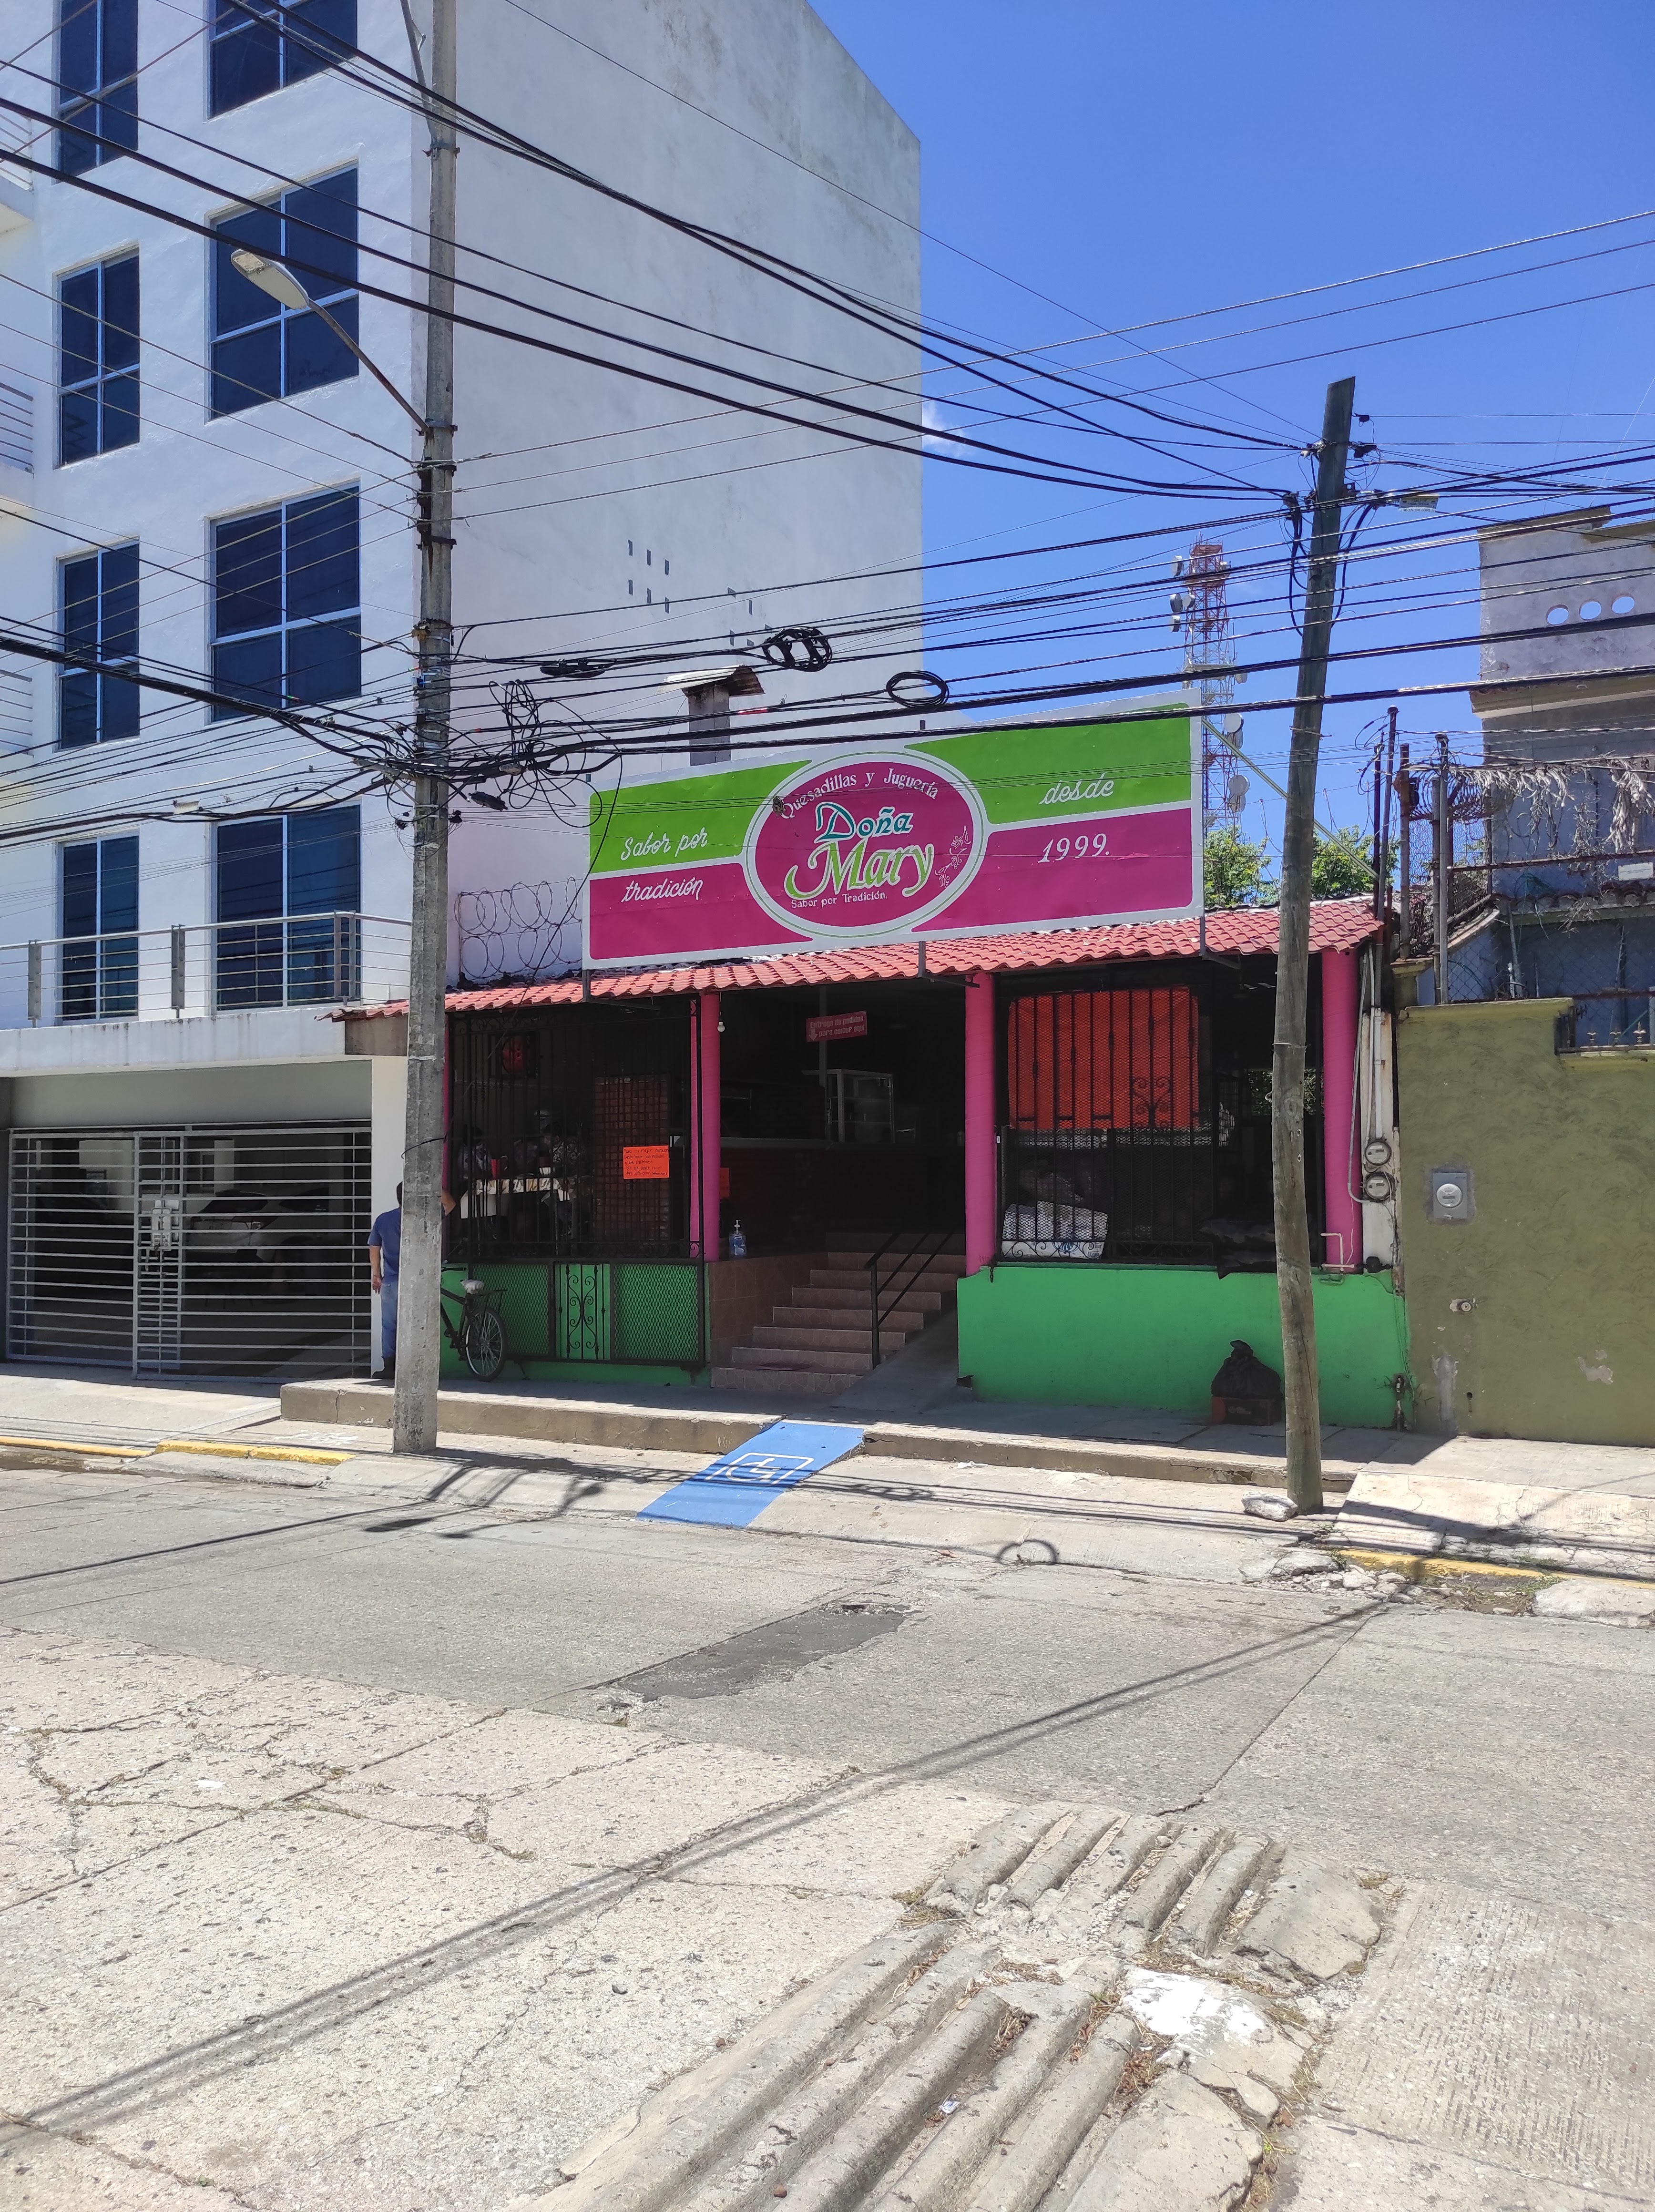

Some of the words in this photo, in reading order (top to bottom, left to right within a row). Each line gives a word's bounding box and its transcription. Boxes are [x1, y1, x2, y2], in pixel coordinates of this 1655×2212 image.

[780, 773, 857, 819] Quesadillas
[865, 772, 876, 787] y
[883, 768, 939, 799] Juguería
[1038, 772, 1114, 805] desde
[814, 801, 914, 843] Doña
[620, 831, 671, 861] Sabor
[674, 827, 708, 858] por
[1038, 833, 1110, 863] 1999.
[784, 839, 934, 901] Mary
[621, 876, 704, 903] tradición
[791, 899, 818, 909] Sabor
[821, 897, 838, 909] por
[810, 1020, 834, 1028] Entrega
[843, 1015, 864, 1025] pedidos
[818, 1029, 833, 1037] para
[834, 1026, 852, 1035] comer
